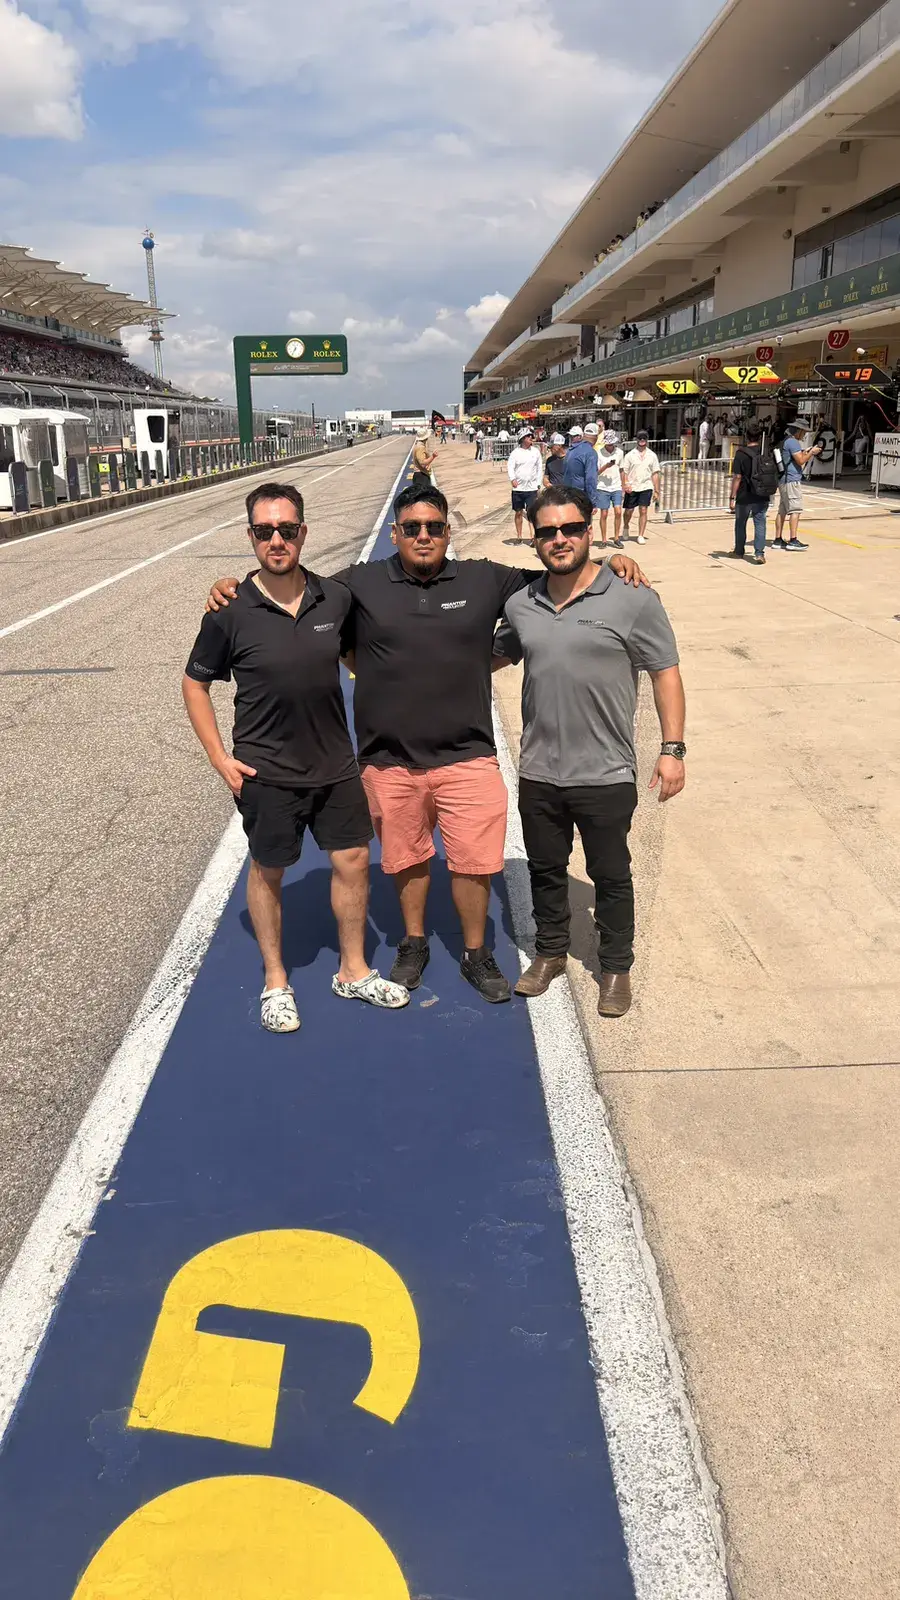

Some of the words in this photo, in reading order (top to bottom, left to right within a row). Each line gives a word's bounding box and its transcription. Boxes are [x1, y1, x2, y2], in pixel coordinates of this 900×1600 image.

[871, 282, 888, 295] ROLEX
[843, 291, 860, 303] ROLEX
[832, 332, 845, 345] 27
[759, 348, 769, 359] 26
[709, 360, 718, 369] 25
[738, 367, 758, 383] 92
[854, 368, 873, 381] 19
[673, 381, 687, 393] 91
[624, 390, 634, 401] 12
